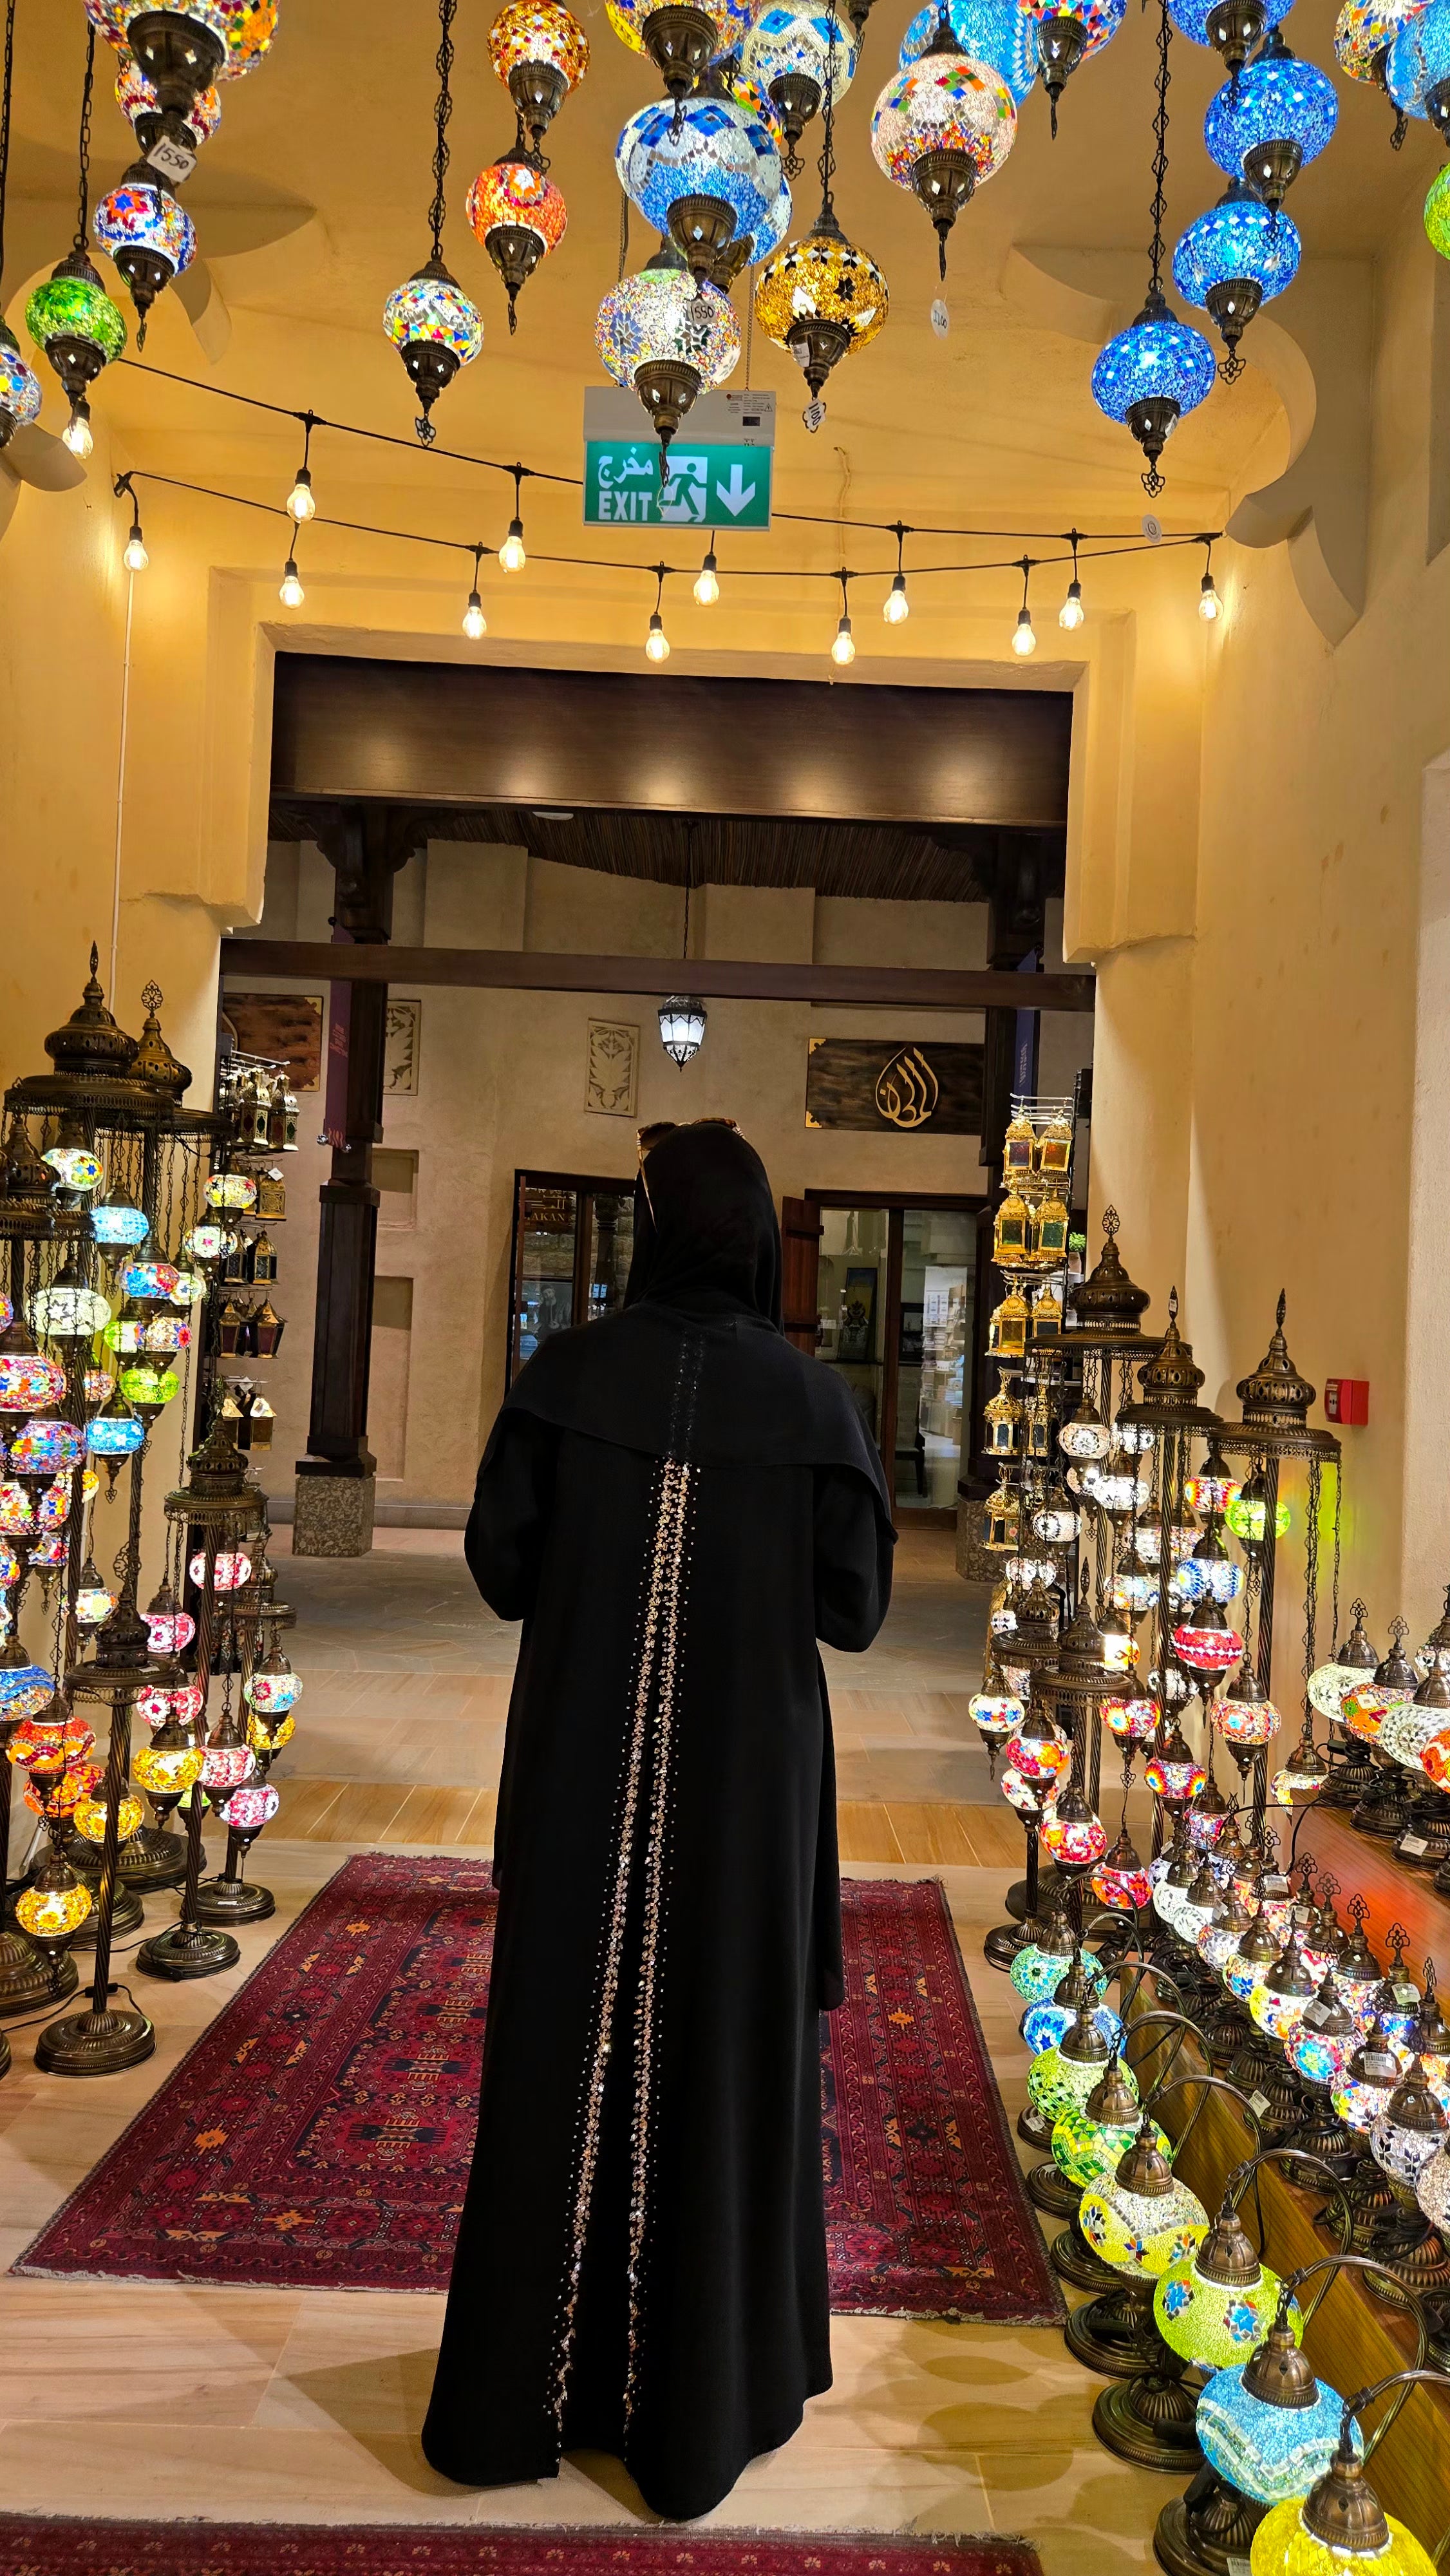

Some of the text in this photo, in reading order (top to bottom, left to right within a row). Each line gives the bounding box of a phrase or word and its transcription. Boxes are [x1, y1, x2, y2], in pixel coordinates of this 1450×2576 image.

[153, 143, 189, 169] 1550
[690, 305, 714, 321] 1550
[808, 402, 822, 426] 1100
[598, 446, 654, 489] مخرج
[598, 491, 653, 522] EXIT
